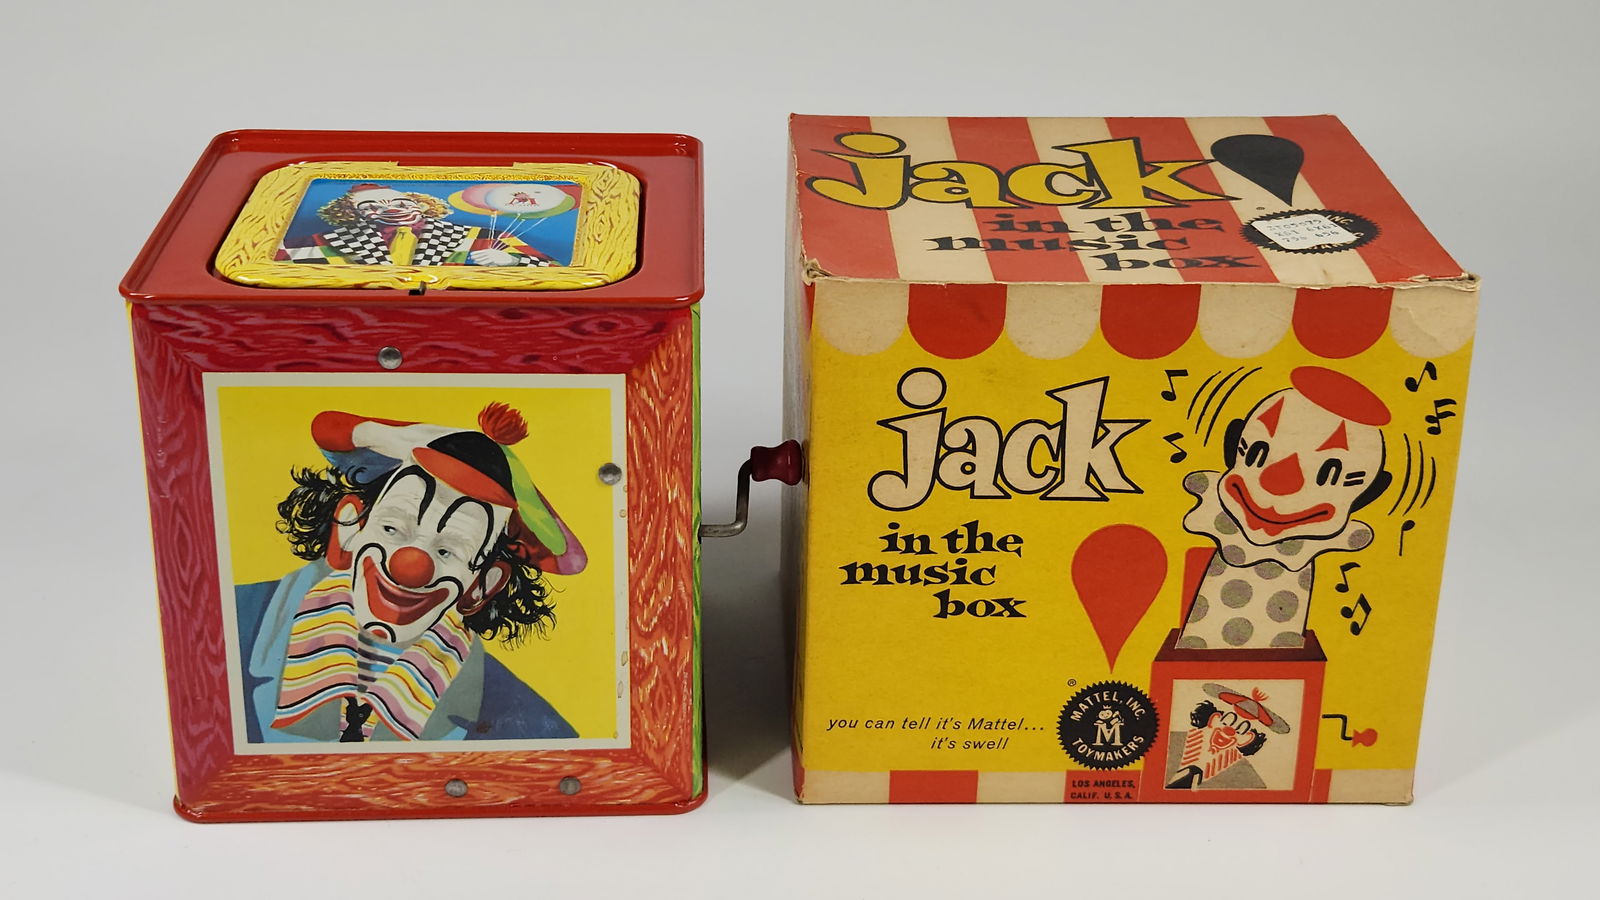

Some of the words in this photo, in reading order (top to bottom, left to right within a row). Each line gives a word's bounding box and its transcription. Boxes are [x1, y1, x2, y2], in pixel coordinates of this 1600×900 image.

[982, 213, 1079, 234] in
[1085, 211, 1225, 233] the
[923, 234, 1193, 251] music
[1089, 252, 1263, 271] box
[867, 367, 1151, 512] jack
[878, 522, 937, 556] in
[941, 519, 1024, 558] the
[838, 557, 997, 586] music
[932, 588, 1027, 618] box
[826, 717, 859, 731] you
[864, 718, 895, 730] can
[901, 717, 932, 730] tell
[935, 717, 962, 730] it's
[967, 717, 1045, 731] Mattel...
[930, 736, 957, 750] it's
[962, 737, 1009, 750] swell
[1072, 735, 1144, 761] TOYMAKERS
[1072, 780, 1090, 788] LOS
[1093, 780, 1136, 789] ANGELES,
[1070, 791, 1099, 800] CALIF.
